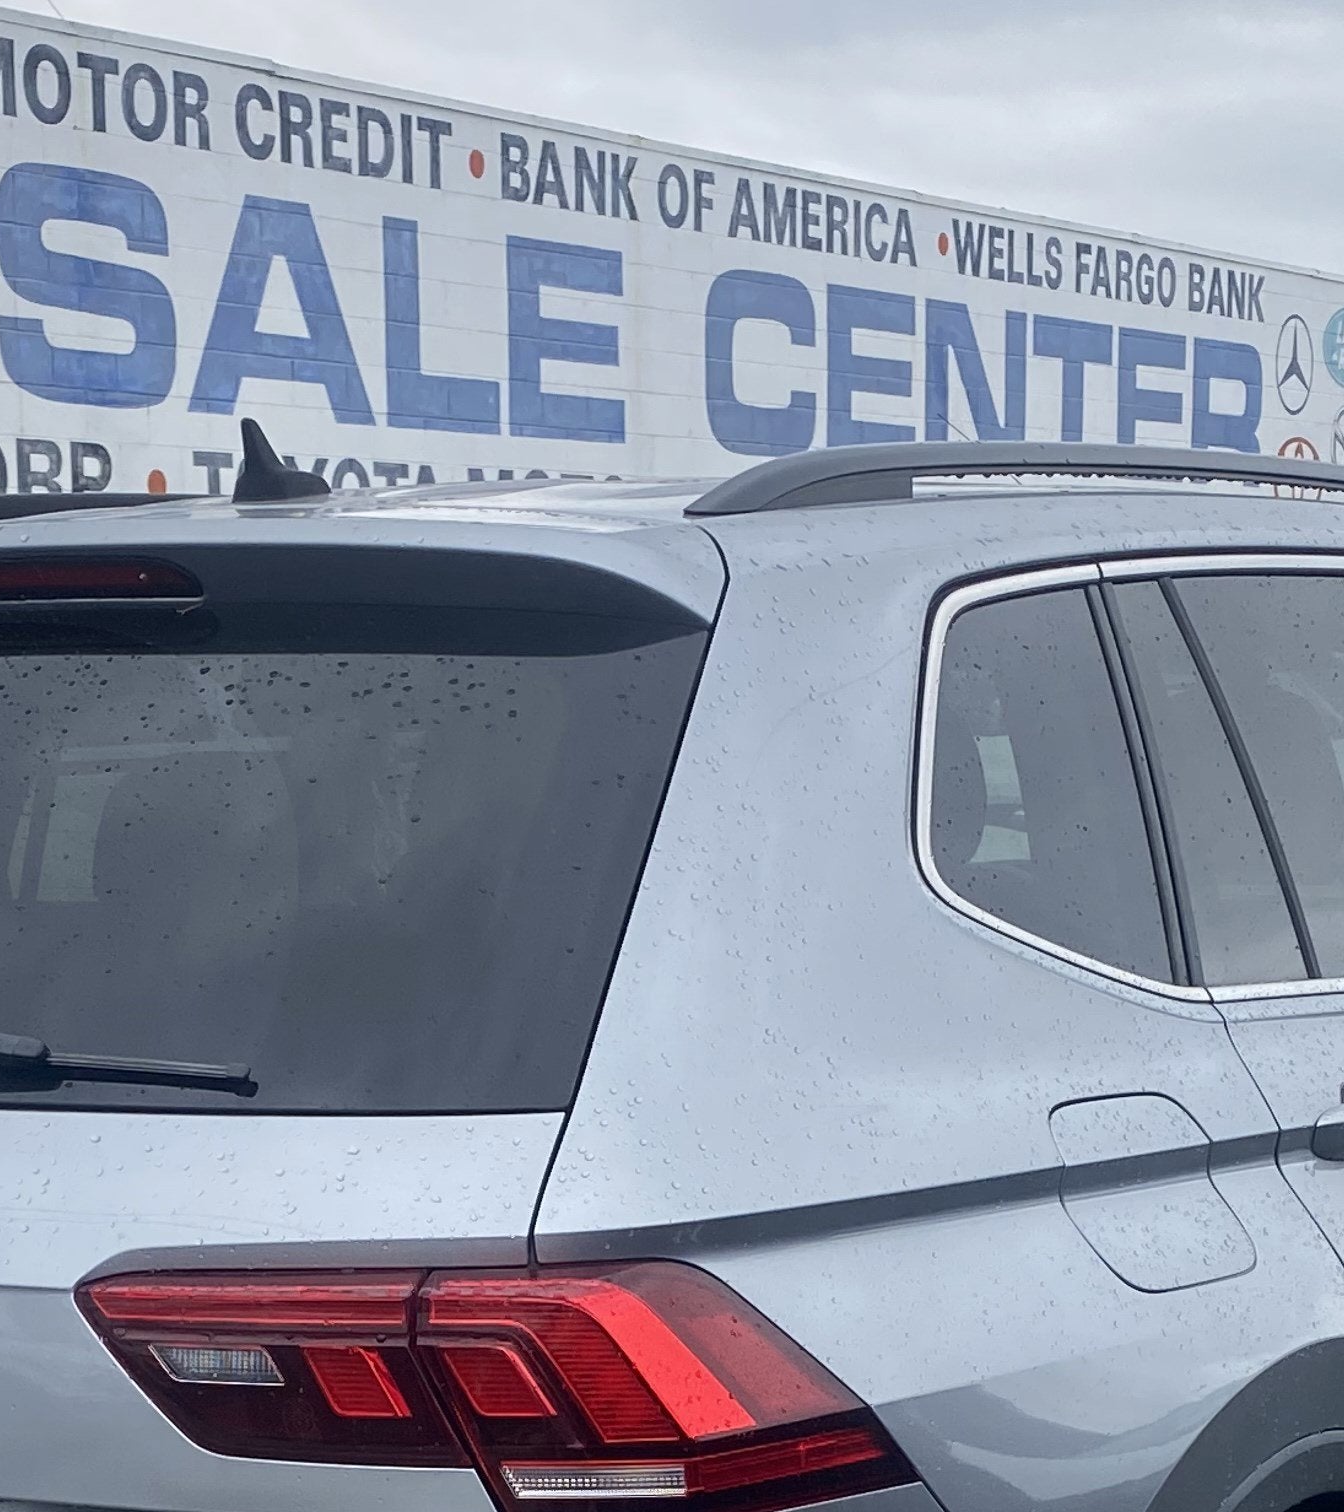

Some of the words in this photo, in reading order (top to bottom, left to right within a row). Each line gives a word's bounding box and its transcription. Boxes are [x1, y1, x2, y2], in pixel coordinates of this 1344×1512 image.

[234, 83, 452, 190] CREDIT
[500, 131, 639, 222] BANK
[657, 163, 715, 232] OF
[727, 176, 918, 267] AMERICA
[952, 218, 1063, 291] WELLS
[1075, 241, 1177, 308] FARGO
[1187, 262, 1266, 323] BANK
[704, 268, 1263, 457] CENTER
